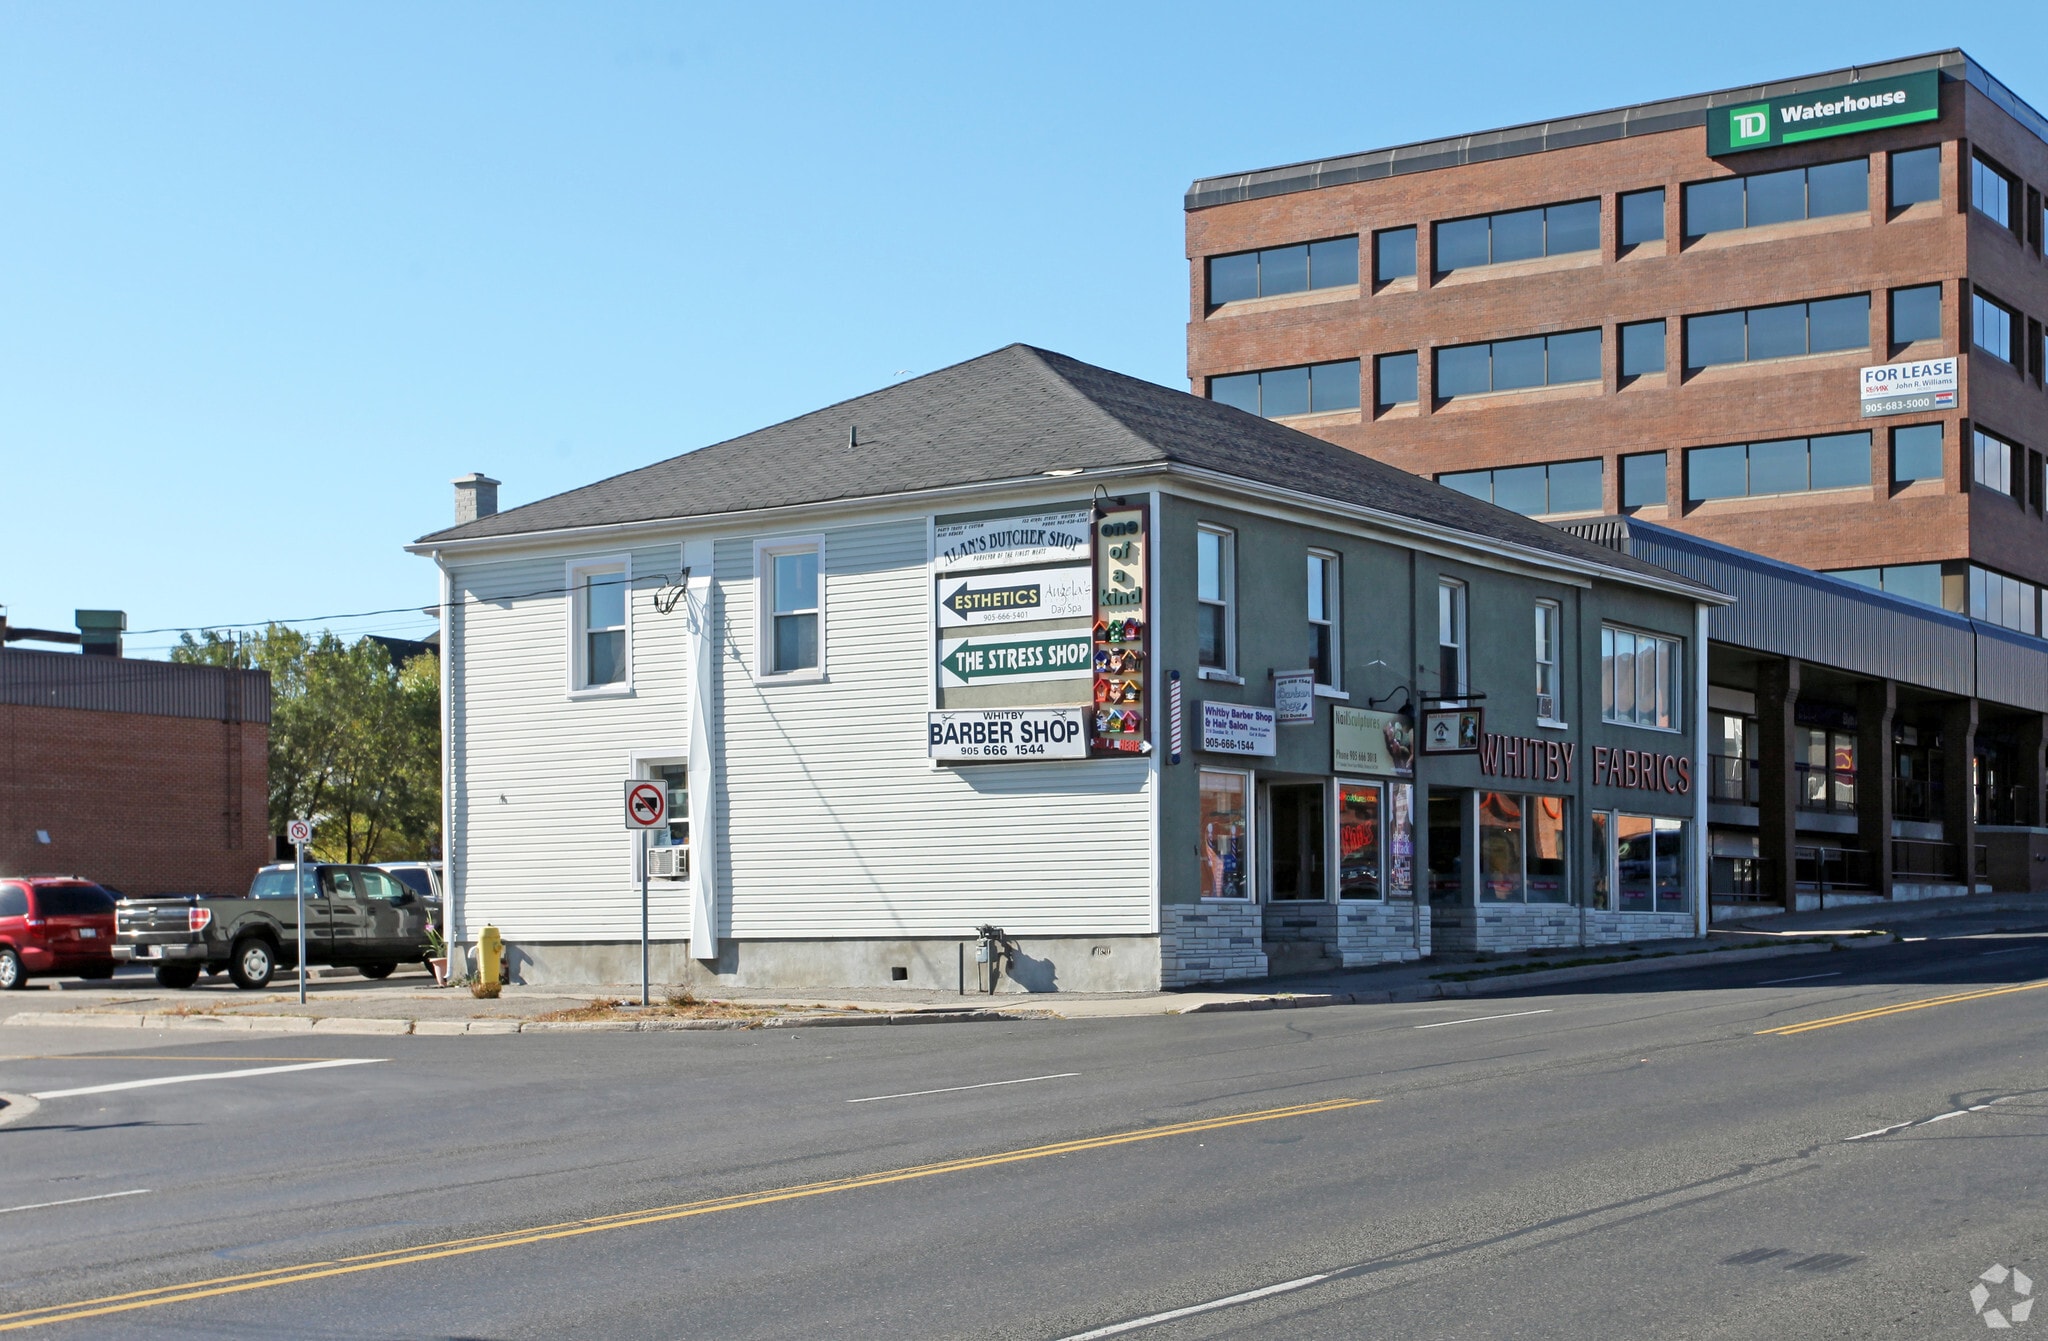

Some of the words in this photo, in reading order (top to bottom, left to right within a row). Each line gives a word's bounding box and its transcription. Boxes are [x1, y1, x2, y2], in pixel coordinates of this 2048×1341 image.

[1733, 112, 1766, 139] TD
[1780, 90, 1906, 123] Waterhouse
[1865, 368, 1898, 383] FOR
[1902, 362, 1952, 379] LEASE
[1896, 382, 1913, 390] John
[1922, 378, 1953, 387] Williams
[1865, 398, 1930, 413] 905-683-5000
[1101, 520, 1138, 537] one
[944, 535, 987, 567] ALAN'S
[989, 529, 1046, 549] BUTCHER
[1048, 530, 1083, 552] SHOP
[1109, 540, 1131, 560] of
[1112, 569, 1125, 583] a
[955, 589, 1038, 610] ESTHETICS
[1100, 586, 1142, 606] kind
[983, 611, 1029, 621] 905-666-5401
[1051, 604, 1066, 616] Day
[1067, 603, 1082, 615] Spa
[955, 650, 984, 674] THE
[988, 646, 1044, 670] STRESS
[1048, 643, 1089, 667] SHOP
[983, 711, 1025, 720] WHITBY
[1205, 706, 1230, 719] Whitby
[1231, 709, 1254, 720] Barber
[1255, 711, 1273, 724] Shop
[930, 721, 1014, 745] BARBER
[1020, 719, 1080, 744] SHOP
[1205, 717, 1211, 727] &
[1212, 718, 1227, 729] Hair
[1229, 719, 1248, 731] Salon
[960, 747, 979, 755] 905
[983, 745, 1008, 756] 666
[1014, 744, 1045, 755] 1544
[1119, 739, 1140, 752] HERE
[1205, 737, 1255, 751] 905-666-1544
[1335, 749, 1349, 760] Phone
[1349, 750, 1358, 761] 905
[1479, 733, 1576, 783] WHITBY
[1592, 746, 1691, 796] FABRICS
